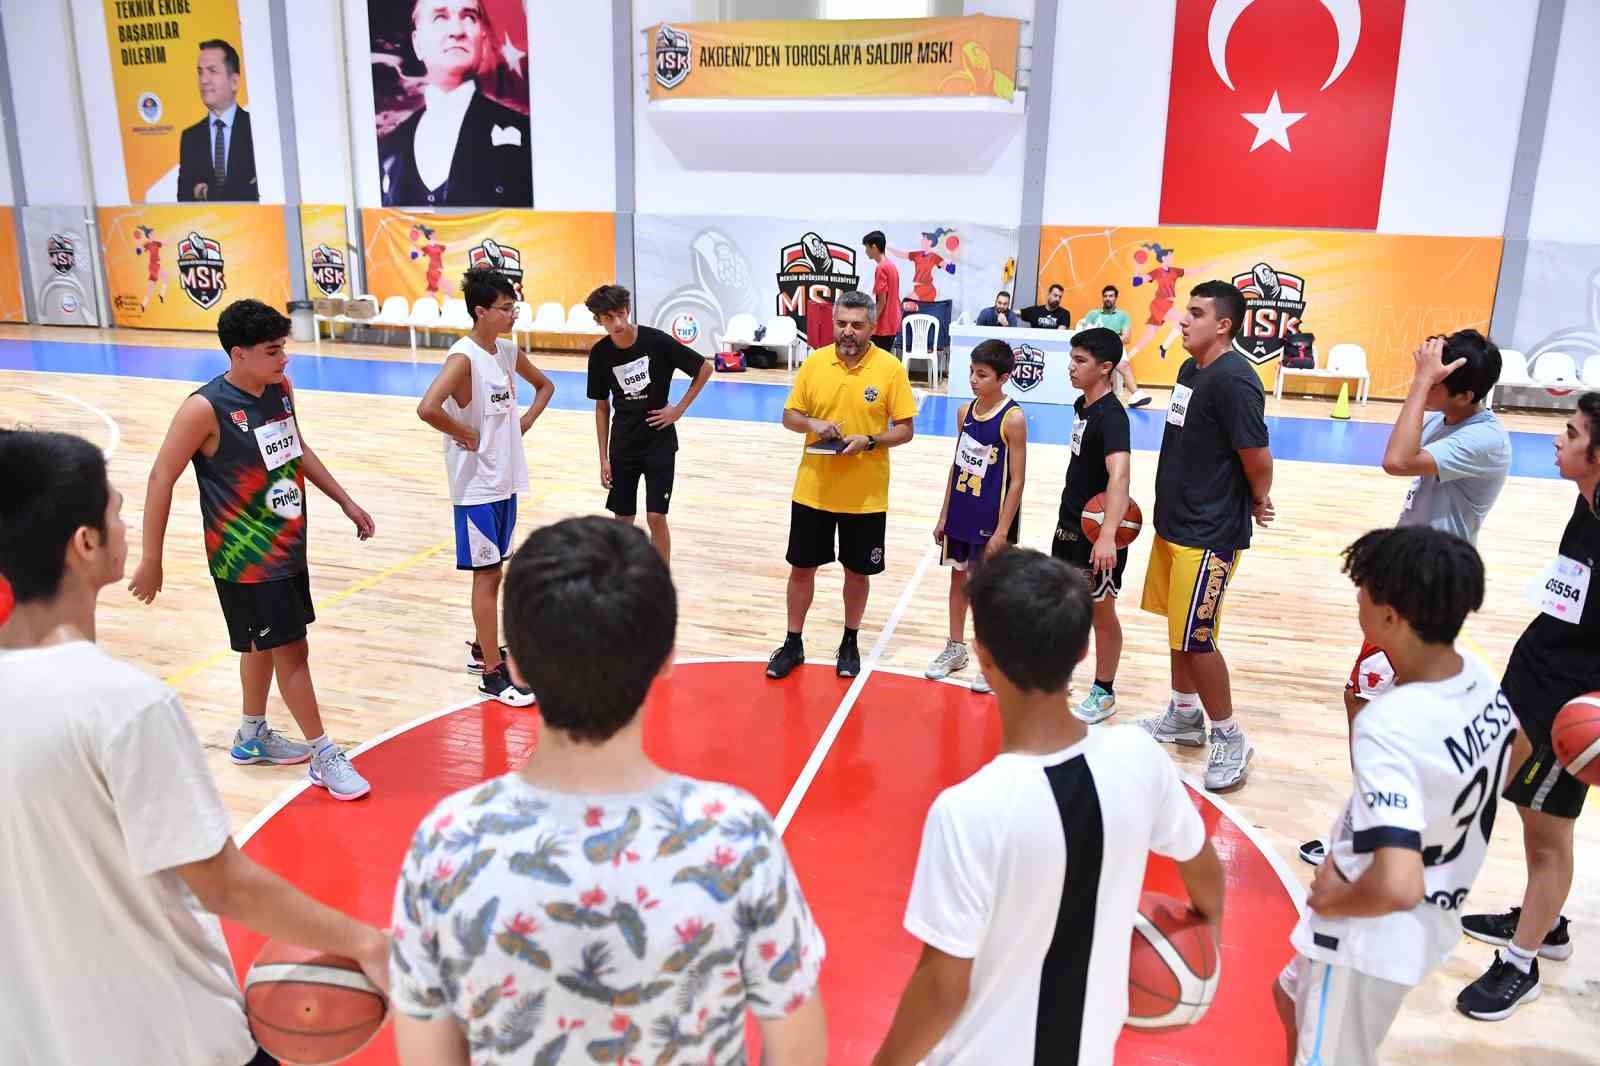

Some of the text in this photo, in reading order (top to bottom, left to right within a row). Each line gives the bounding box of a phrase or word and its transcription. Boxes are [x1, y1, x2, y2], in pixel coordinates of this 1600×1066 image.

[700, 41, 953, 67] AKDENİZ'DEN TOROSLAR'A SALDIR MSK!
[180, 266, 227, 290] MSK
[313, 267, 346, 285] MSK
[1010, 364, 1044, 381] MSK
[265, 435, 294, 456] 06137
